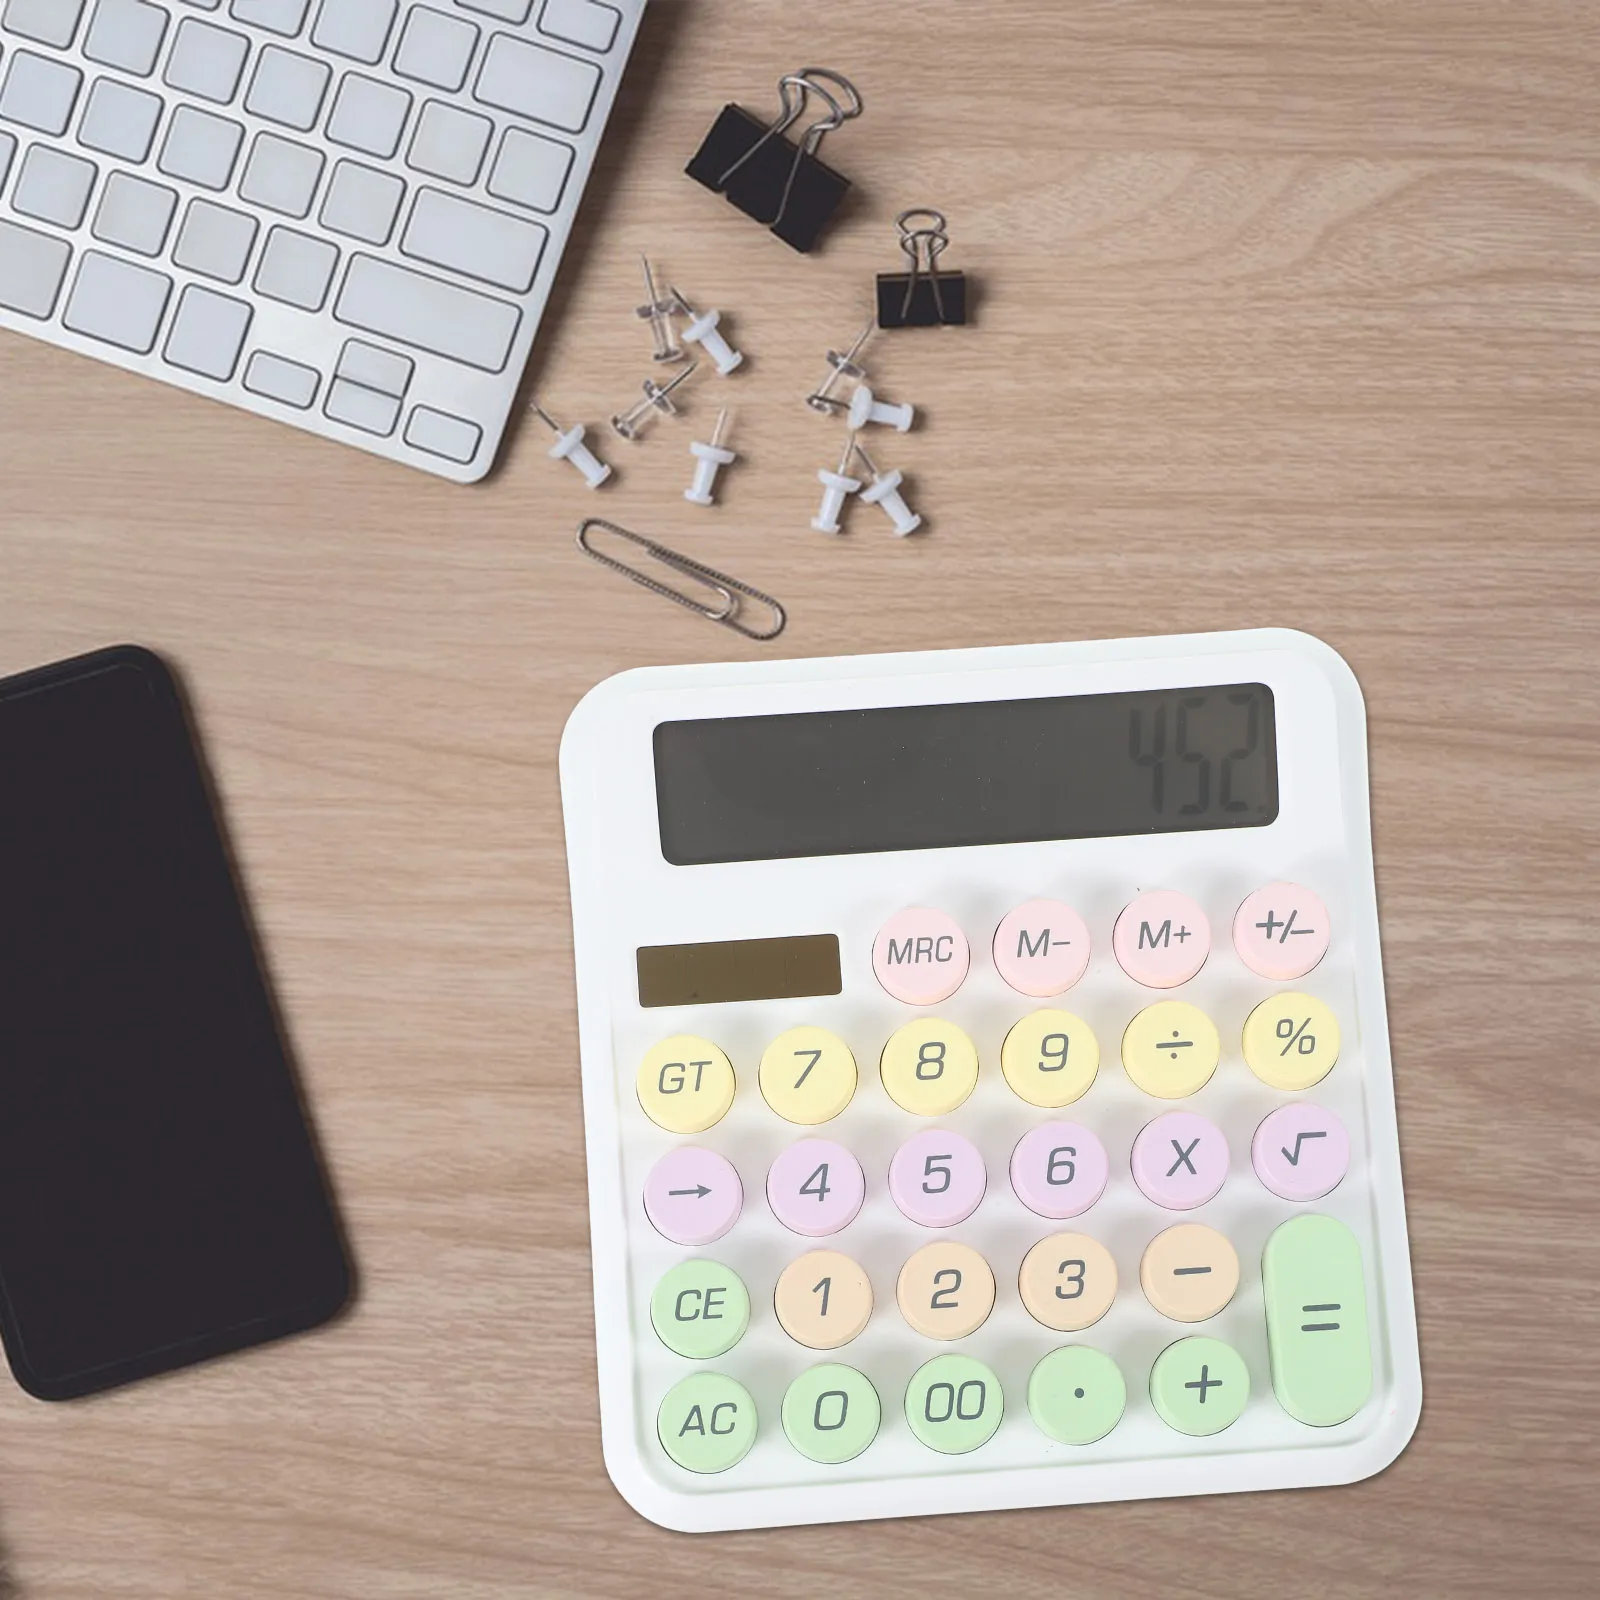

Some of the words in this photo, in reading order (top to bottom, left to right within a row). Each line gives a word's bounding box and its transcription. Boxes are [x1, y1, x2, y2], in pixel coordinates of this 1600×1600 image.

[887, 935, 954, 965] MRC
[1138, 919, 1192, 950] M+
[1038, 1033, 1069, 1072] 9
[1275, 1017, 1316, 1057] %
[658, 1060, 713, 1095] GT
[793, 1049, 822, 1089] 7
[915, 1041, 946, 1081] 8
[799, 1163, 831, 1202] 4
[922, 1154, 953, 1194] 5
[1046, 1146, 1077, 1186] 6
[812, 1277, 832, 1317] 1
[930, 1268, 962, 1309] 2
[1055, 1259, 1086, 1300] 3
[674, 1287, 727, 1322] CE
[678, 1402, 738, 1438] AC
[813, 1390, 849, 1431] 0
[924, 1379, 986, 1423] 00
